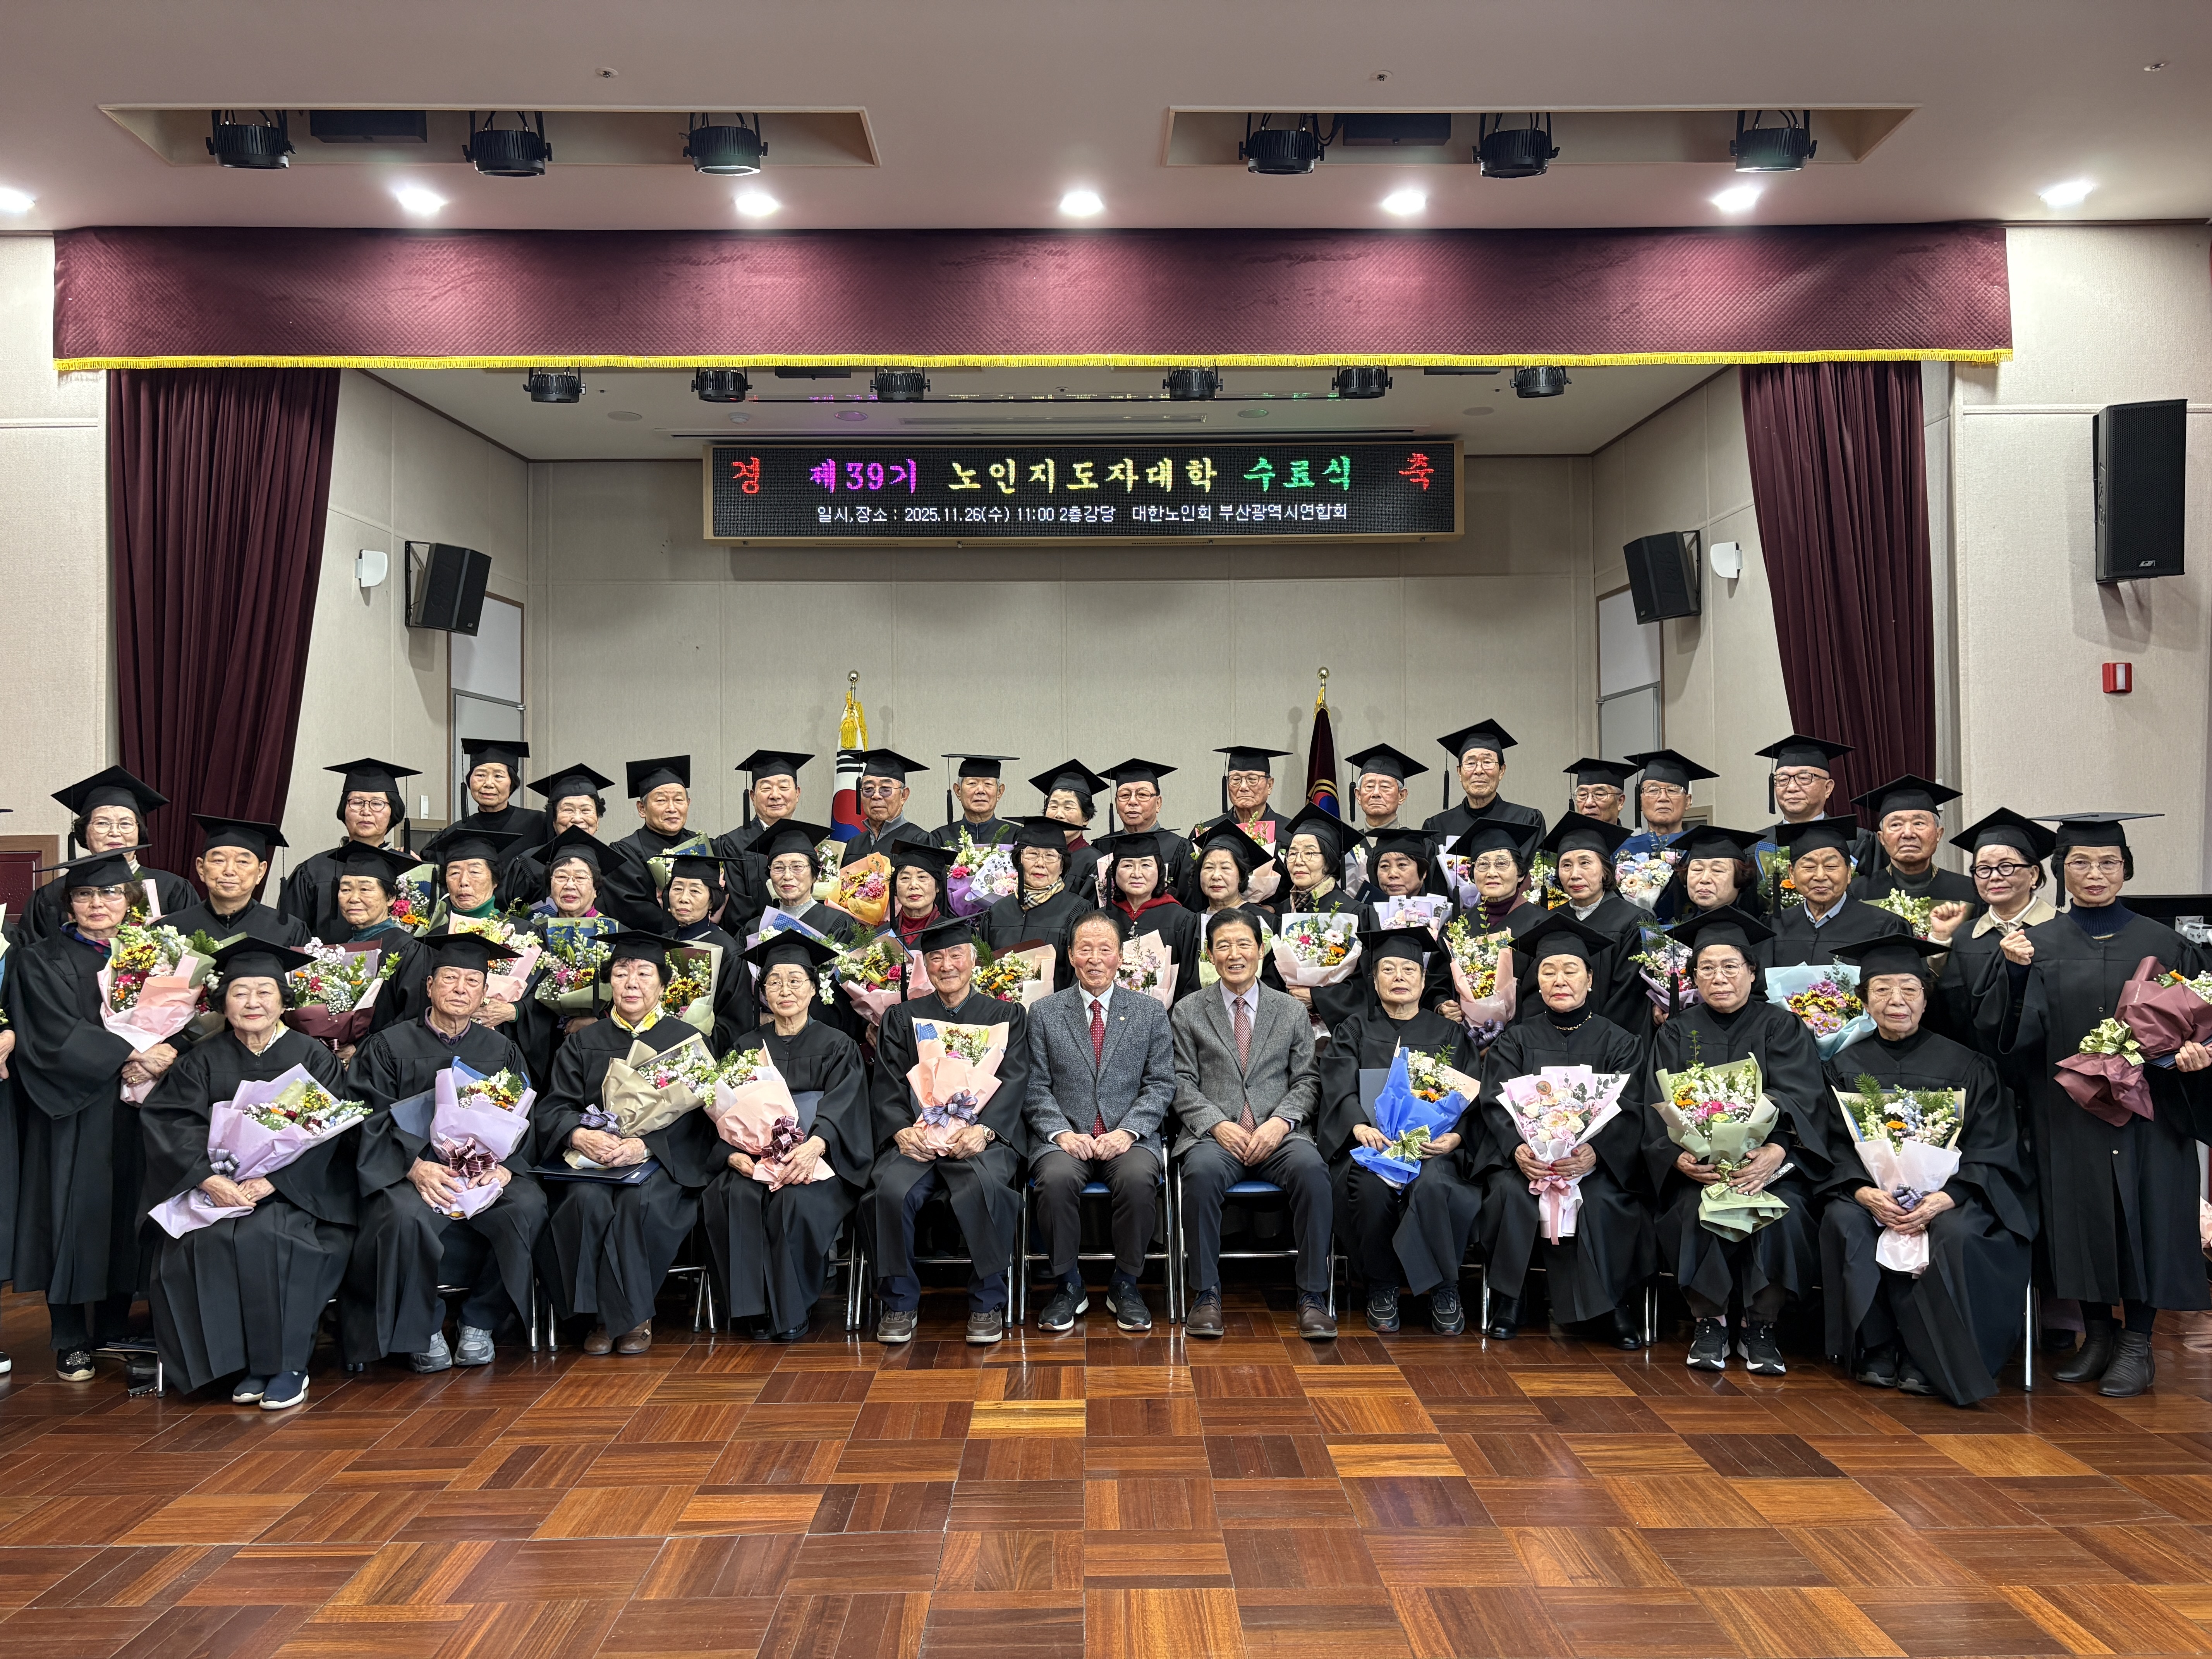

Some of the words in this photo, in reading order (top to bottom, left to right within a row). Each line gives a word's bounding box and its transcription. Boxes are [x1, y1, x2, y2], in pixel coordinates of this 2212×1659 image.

[731, 457, 760, 494] 경
[809, 459, 917, 494] 제39기
[948, 457, 1217, 494] 노인지도자대학
[1243, 456, 1350, 492] 수료식
[1398, 452, 1434, 491] 축
[817, 506, 887, 523] 일시,장소
[905, 506, 1010, 522] 2025.11.26(수)
[1018, 507, 1054, 521] 11:00
[1060, 506, 1116, 522] 2층강당
[1132, 505, 1211, 522] 대한노인회
[1219, 503, 1346, 521] 부산광역시연합회
